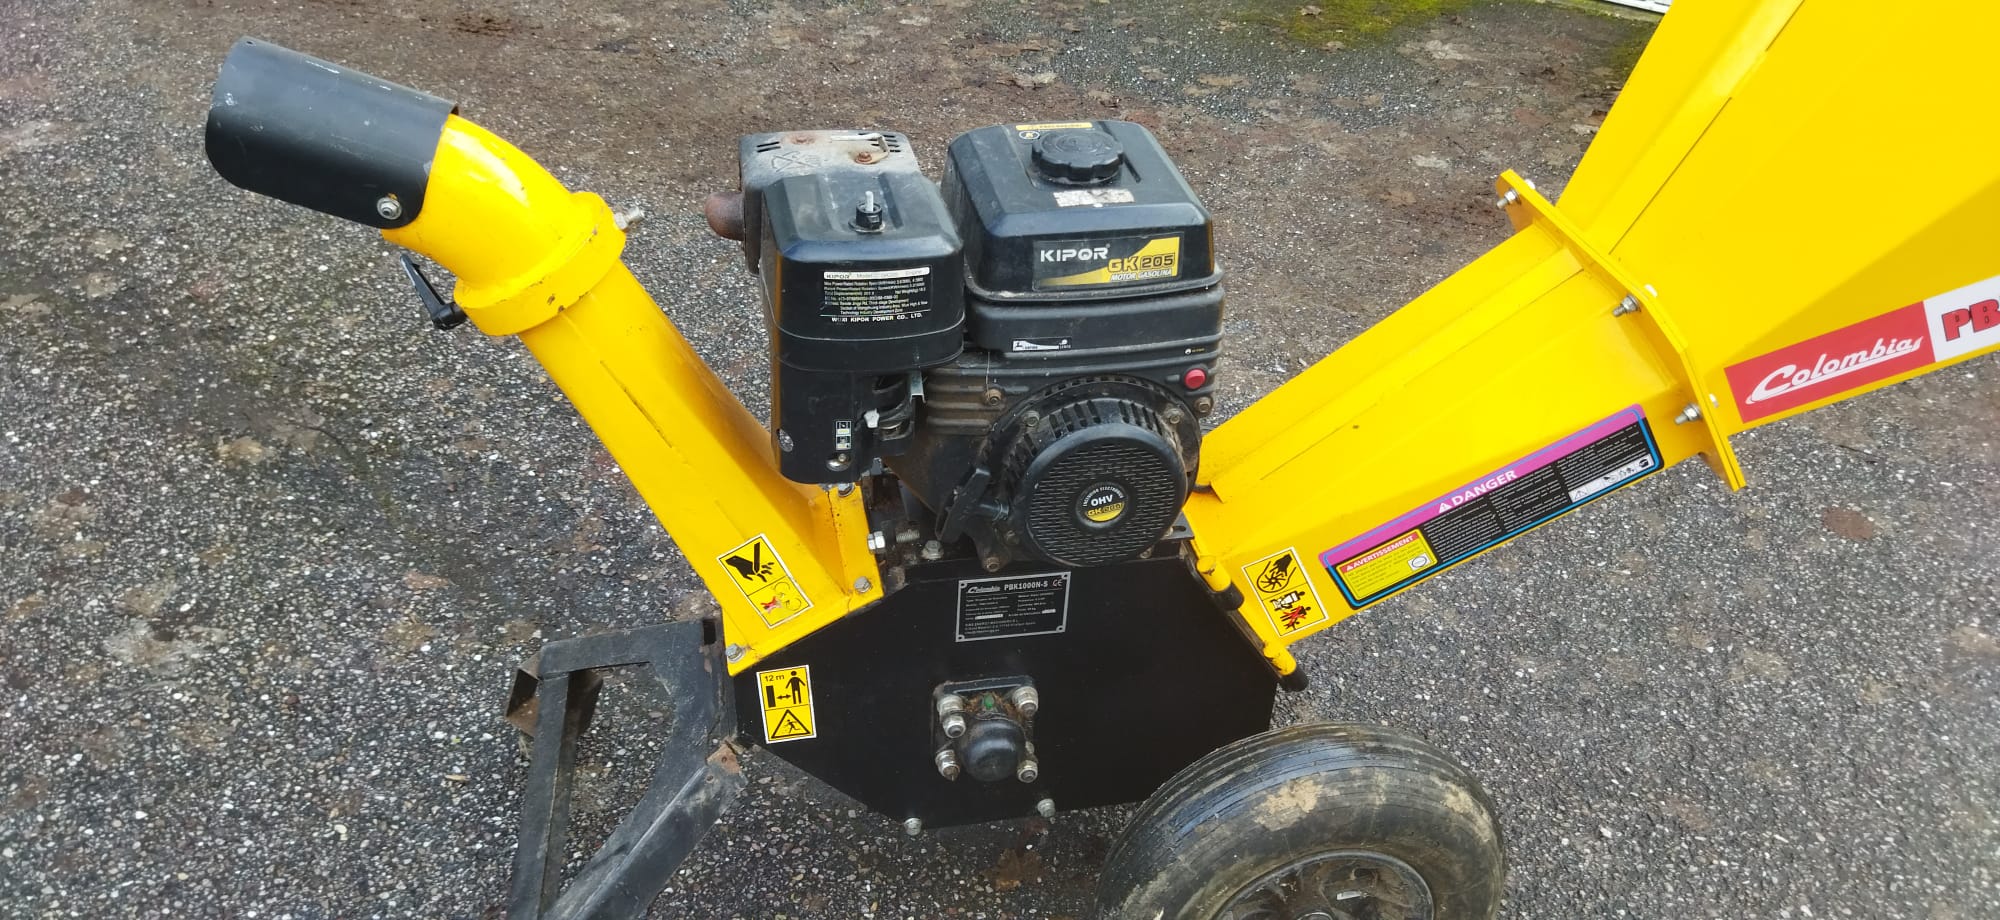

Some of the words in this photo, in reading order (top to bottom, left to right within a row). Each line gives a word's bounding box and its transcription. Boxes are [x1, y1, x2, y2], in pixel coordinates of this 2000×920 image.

[1040, 247, 1108, 262] KIPOR
[1108, 256, 1139, 272] GK
[1141, 255, 1174, 268] 205
[1111, 272, 1137, 281] MOTOR
[1746, 336, 1923, 404] Colombia
[1451, 470, 1518, 506] DANGER
[1090, 494, 1113, 507] OHV
[1352, 535, 1414, 569] AVERTISSEMENT
[764, 674, 774, 682] 12
